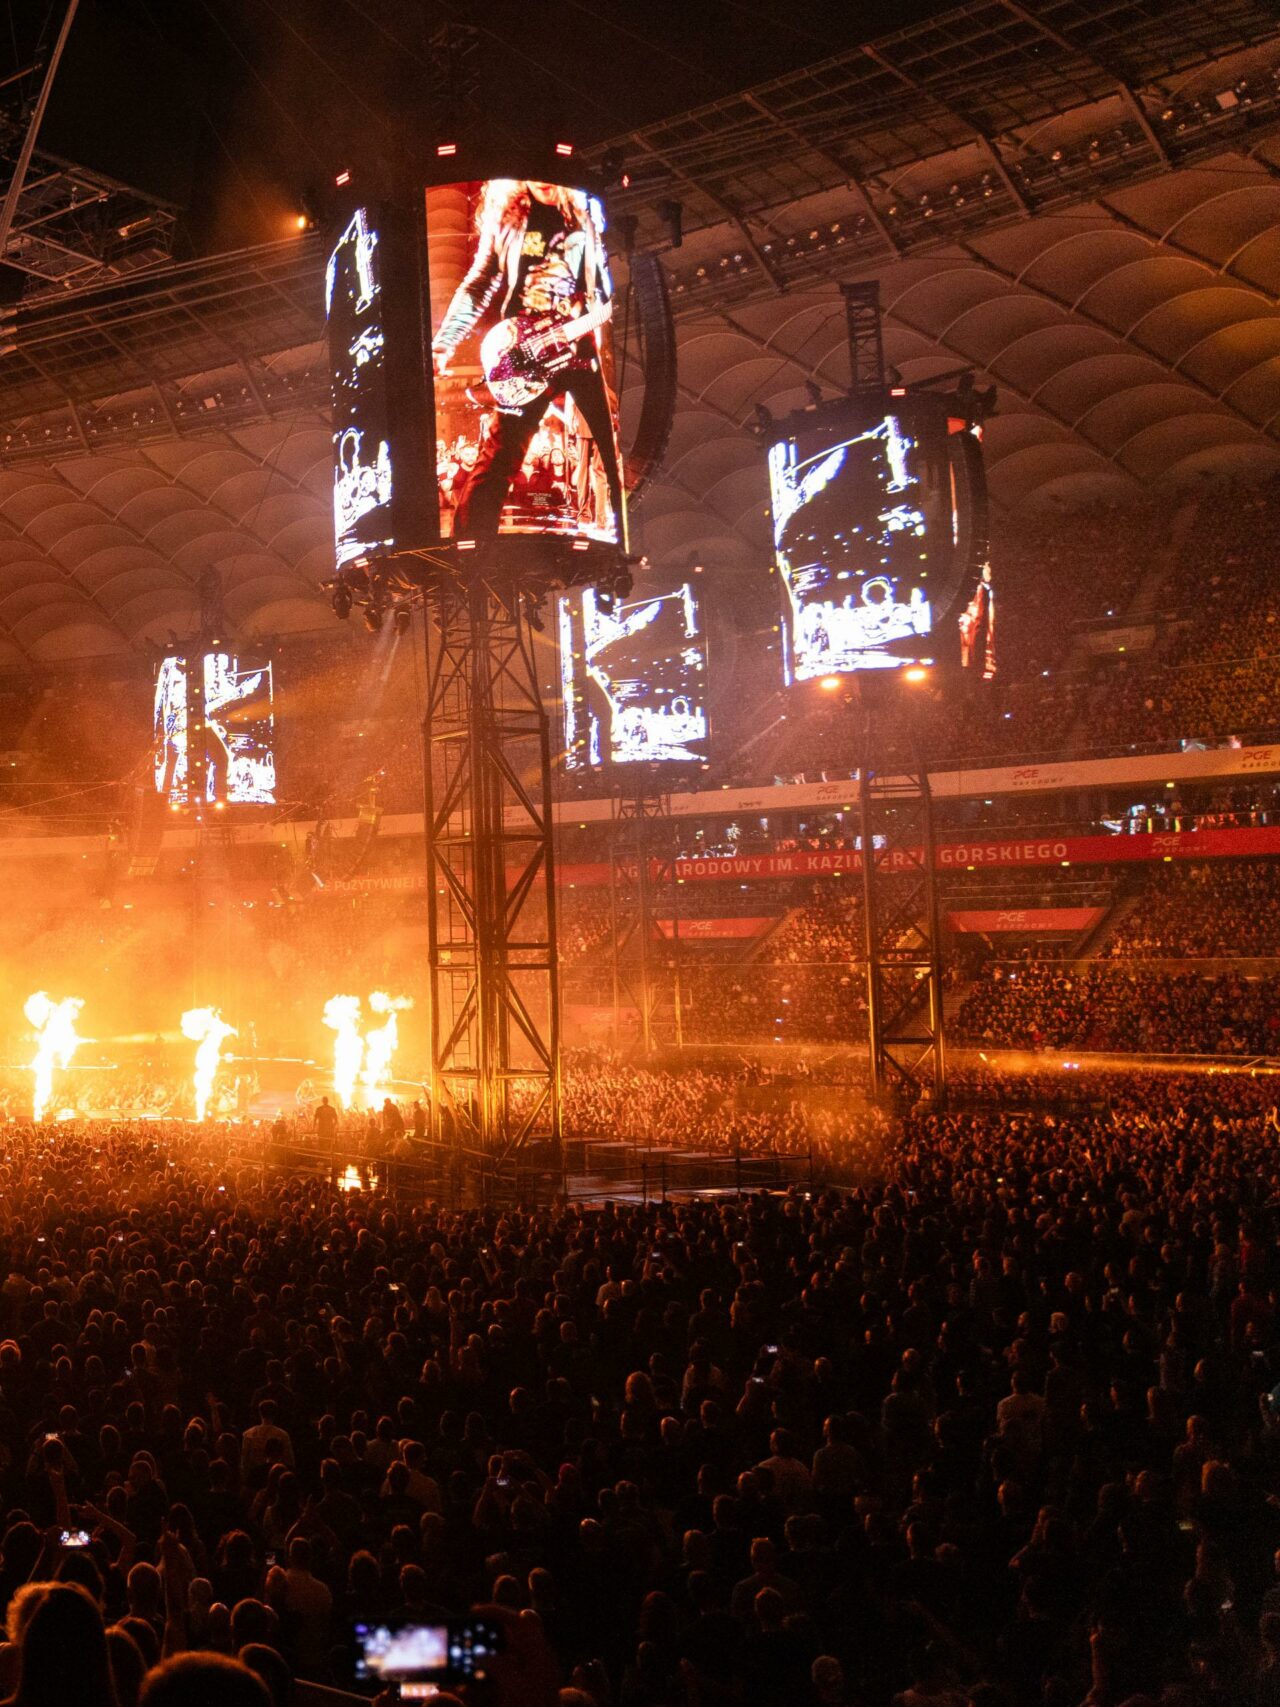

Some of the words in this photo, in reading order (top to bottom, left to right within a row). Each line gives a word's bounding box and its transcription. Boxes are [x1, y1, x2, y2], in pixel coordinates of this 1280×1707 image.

[1242, 750, 1273, 761] PGE
[1013, 769, 1040, 780] PGE
[817, 785, 839, 794] PGE
[1152, 836, 1182, 847] PGE
[770, 858, 800, 871] IM.
[807, 849, 926, 870] KAZIERZ
[940, 843, 1067, 863] GÓRSKIEGO
[997, 912, 1027, 922] PGE
[688, 921, 713, 930] PGE
